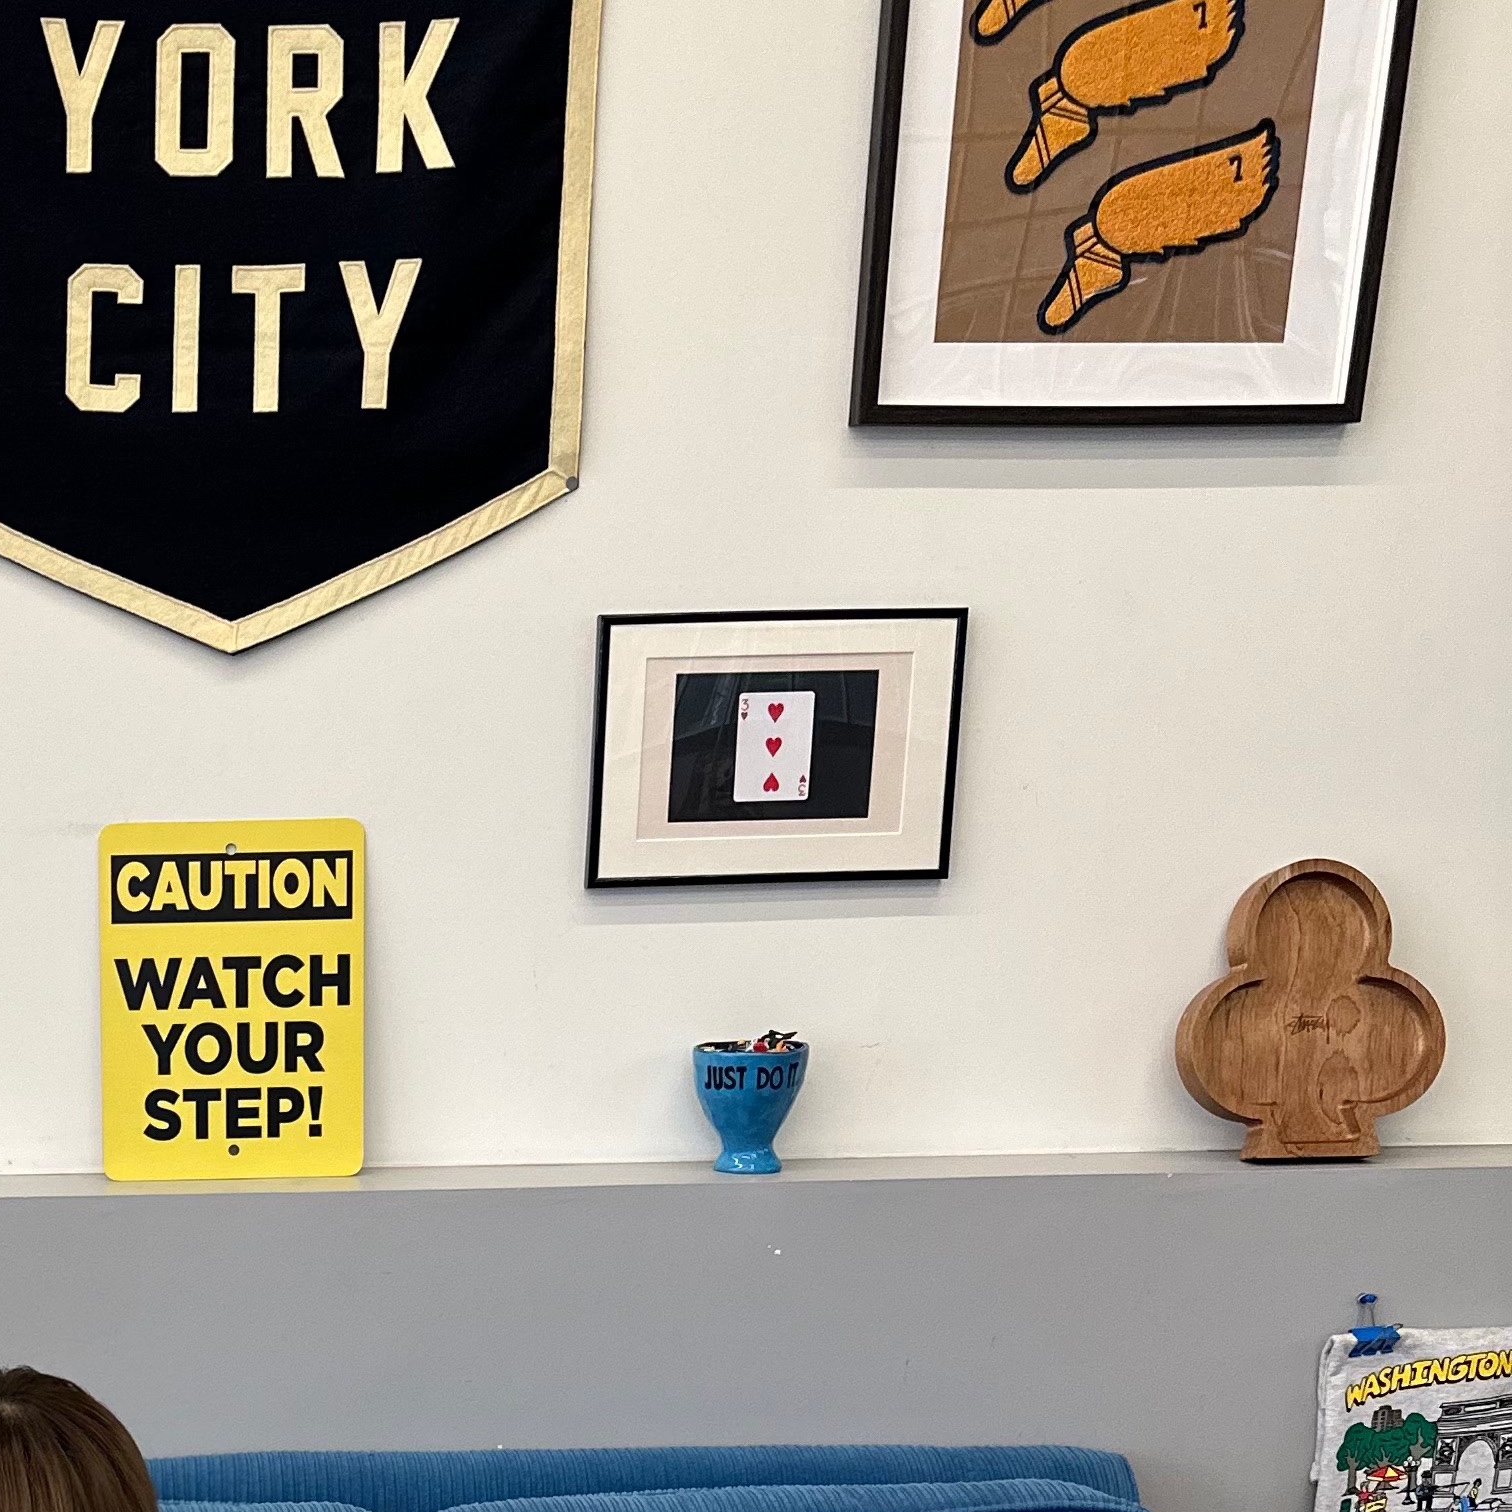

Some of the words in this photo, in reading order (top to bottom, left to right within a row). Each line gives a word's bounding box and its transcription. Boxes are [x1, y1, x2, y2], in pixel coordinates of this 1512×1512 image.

[40, 17, 460, 178] YORK
[65, 258, 422, 413] CITY
[741, 699, 749, 711] 3
[116, 858, 348, 913] CAUTION
[114, 954, 350, 1011] WATCH
[141, 1021, 325, 1076] YOUR
[704, 1065, 747, 1091] JUST
[757, 1066, 783, 1090] DO
[143, 1085, 323, 1141] STEP!
[1345, 1349, 1512, 1413] WASHINGTON
